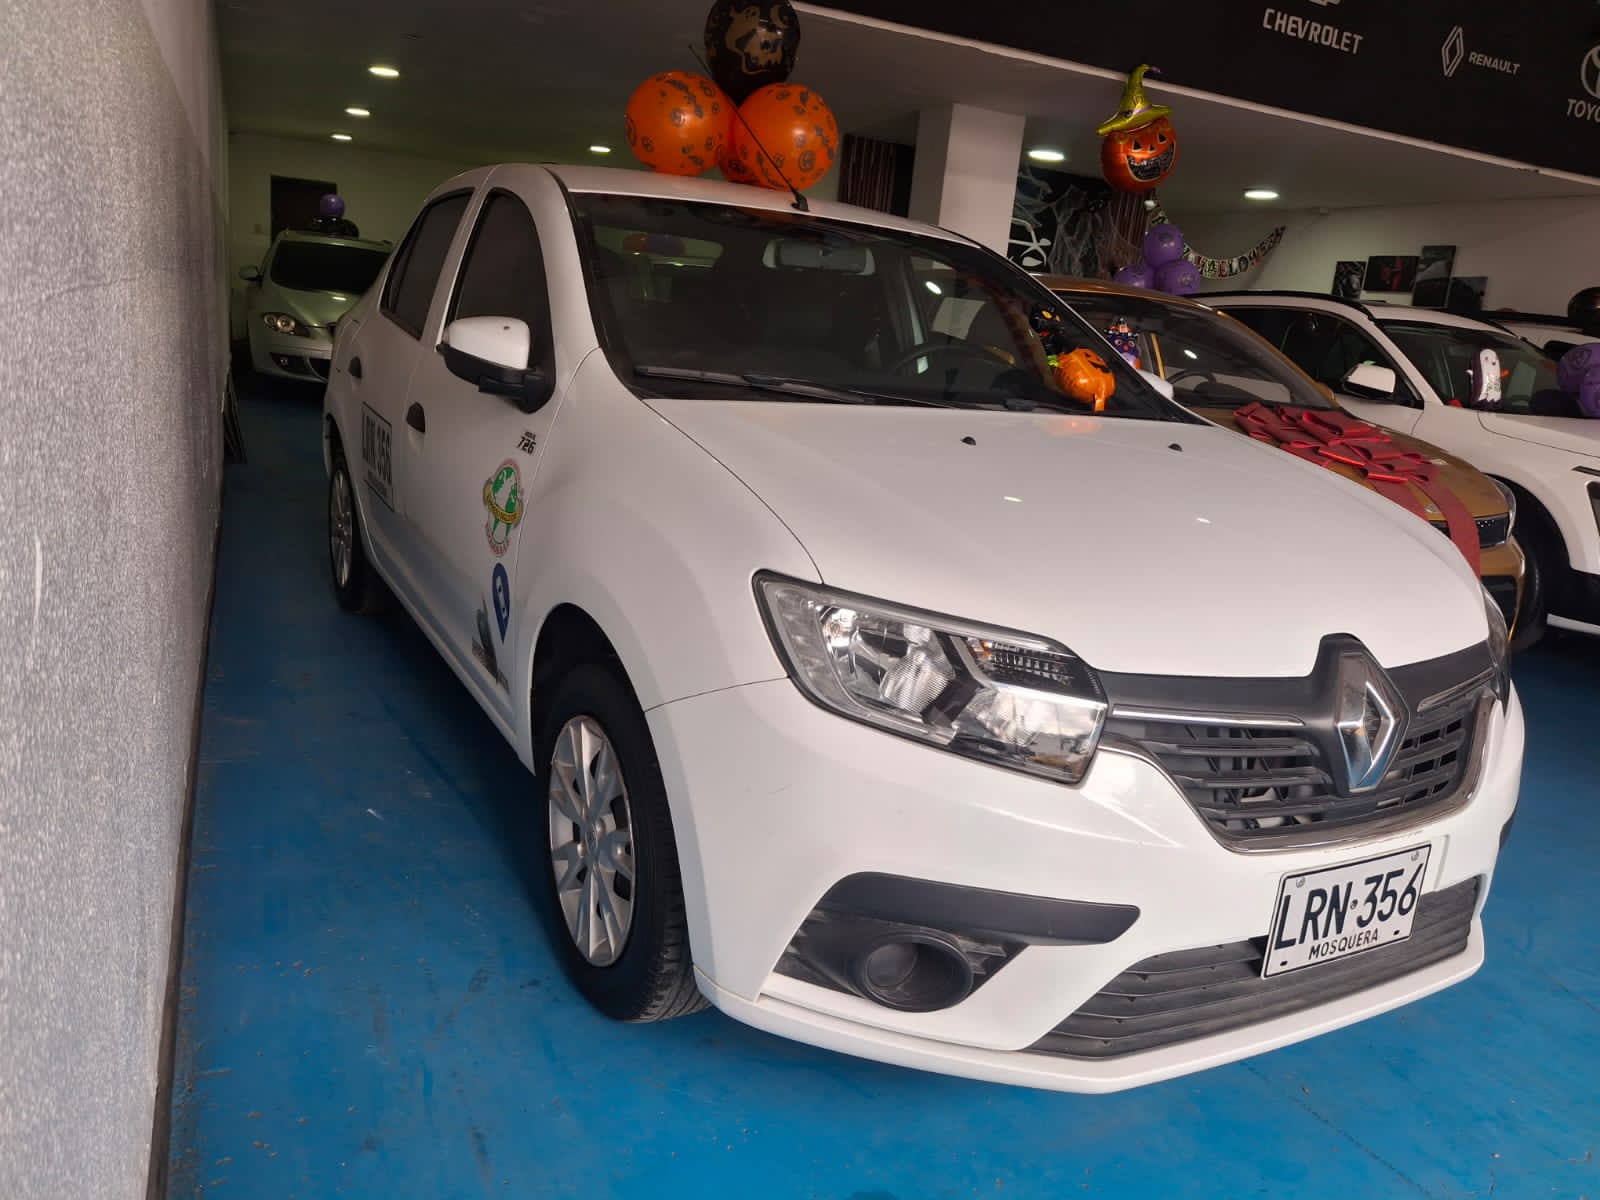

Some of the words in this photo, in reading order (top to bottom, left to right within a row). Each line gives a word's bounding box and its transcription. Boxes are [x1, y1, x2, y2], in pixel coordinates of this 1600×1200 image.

[1263, 8, 1363, 54] CHEVROLET
[1468, 51, 1520, 75] RENAULT
[516, 436, 536, 455] 726
[1308, 927, 1379, 960] MOSQUERA
